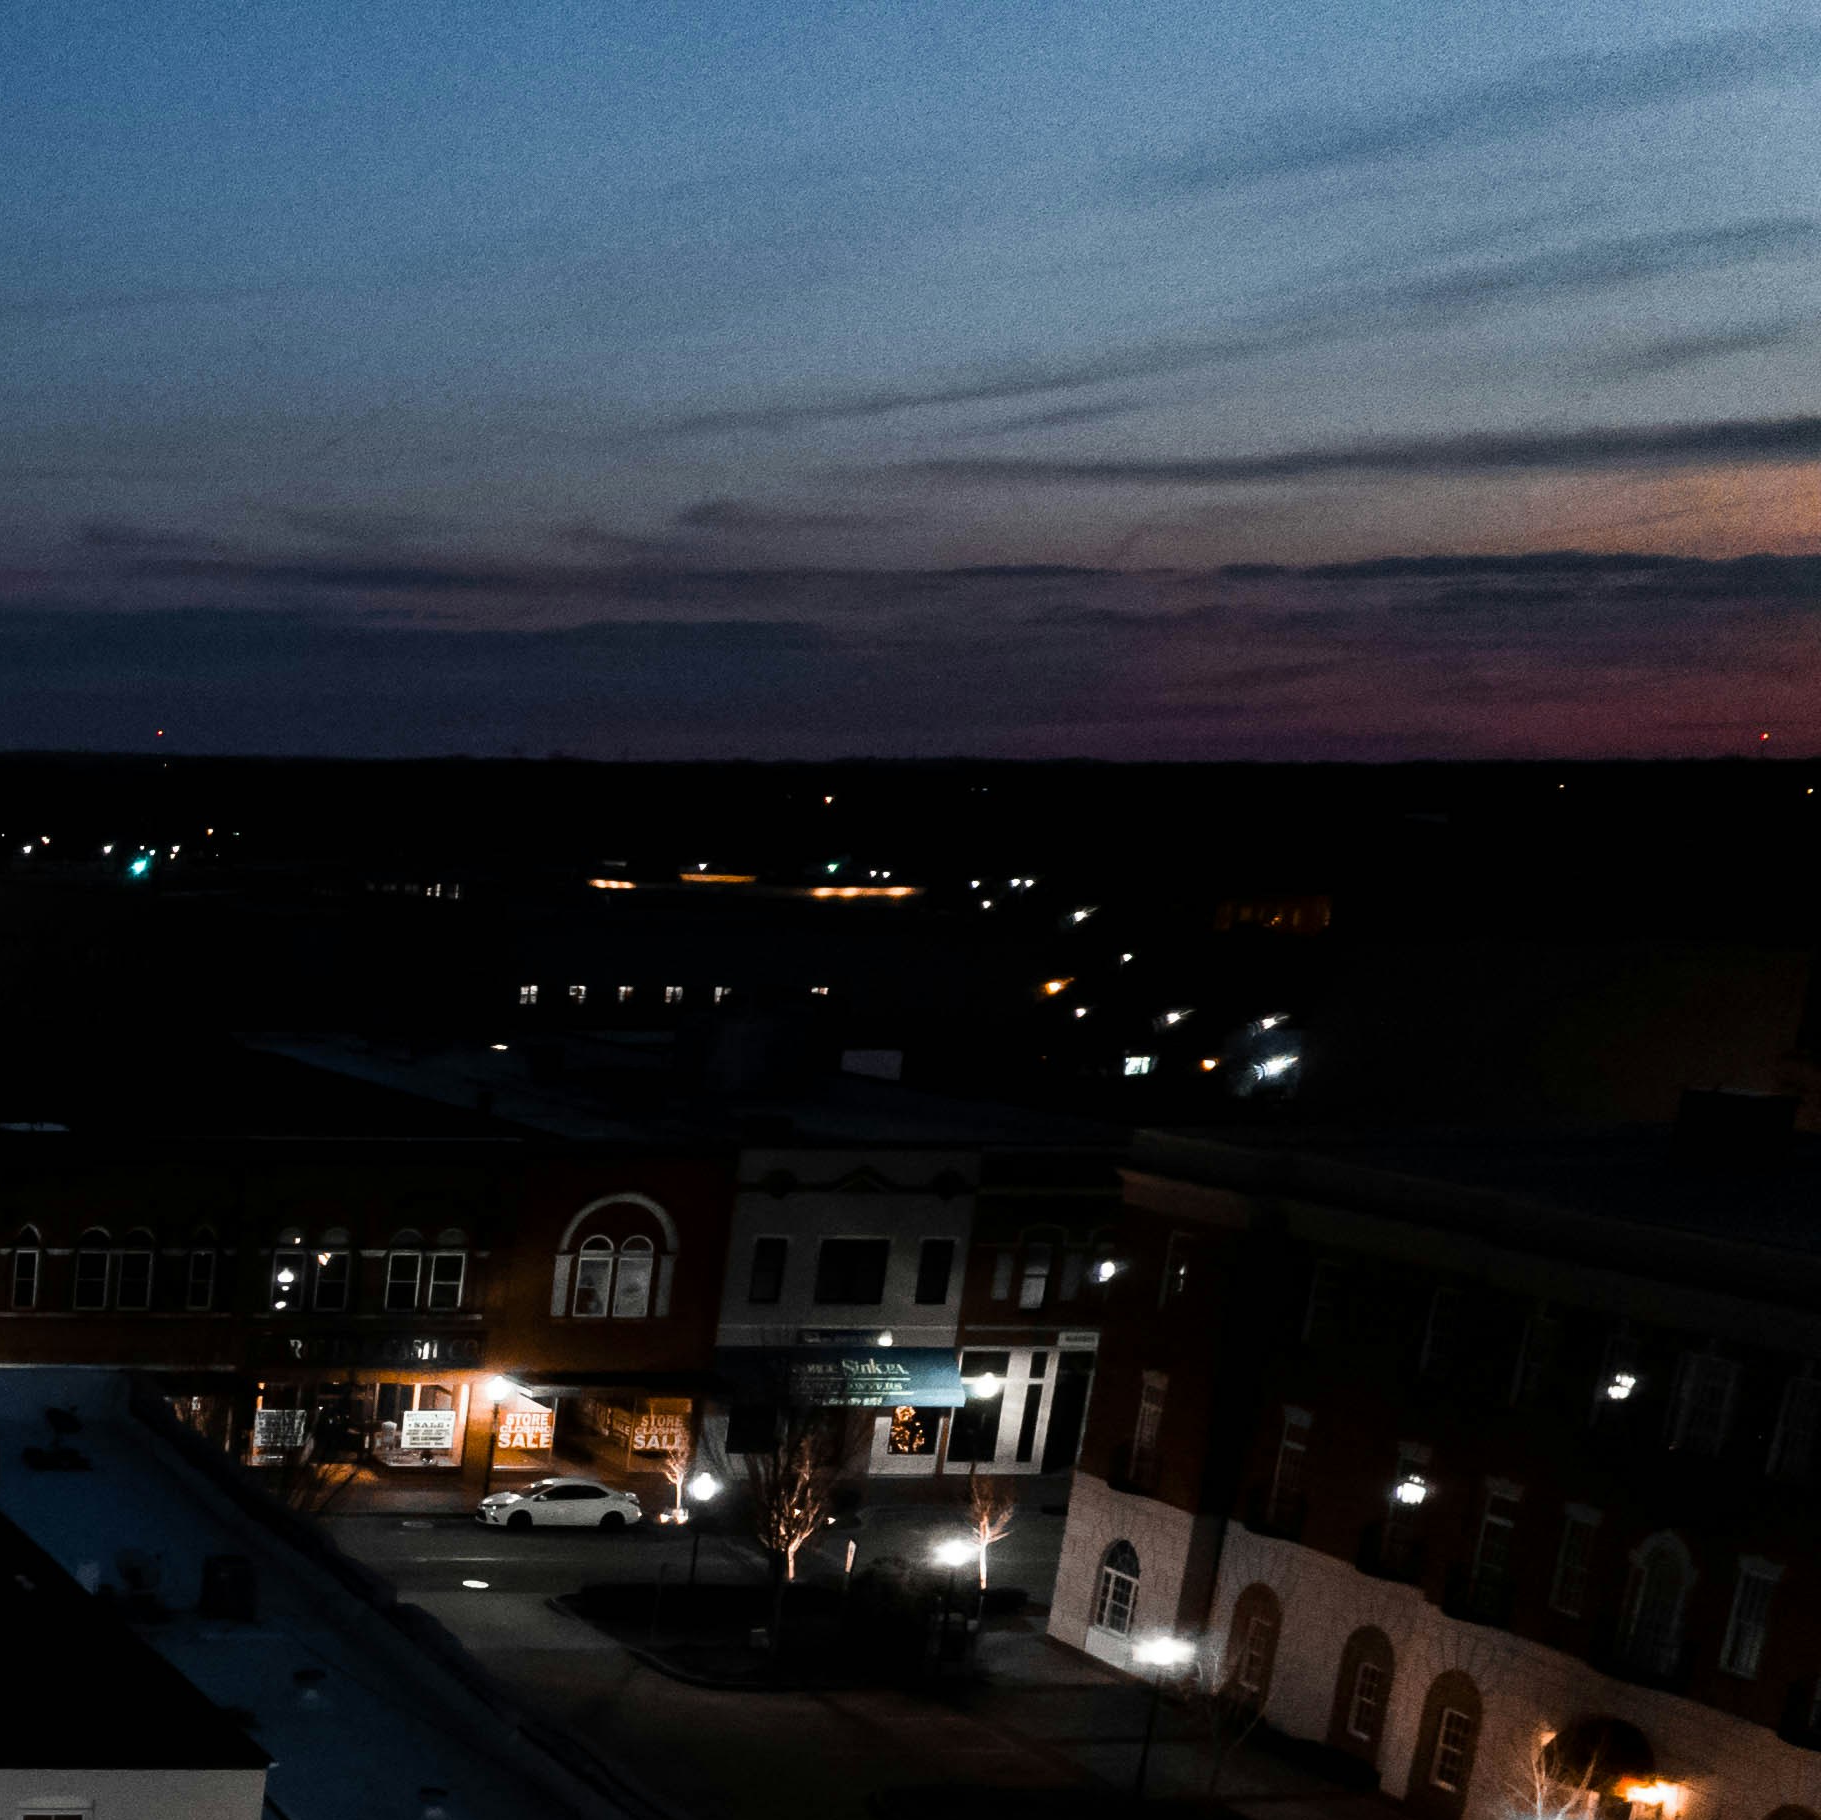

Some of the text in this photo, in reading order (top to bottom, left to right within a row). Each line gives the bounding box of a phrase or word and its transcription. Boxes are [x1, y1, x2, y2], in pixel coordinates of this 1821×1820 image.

[506, 1413, 549, 1425] STORE
[641, 1415, 683, 1427] STORE
[500, 1425, 551, 1434] CLOSING
[497, 1433, 552, 1449] SALE
